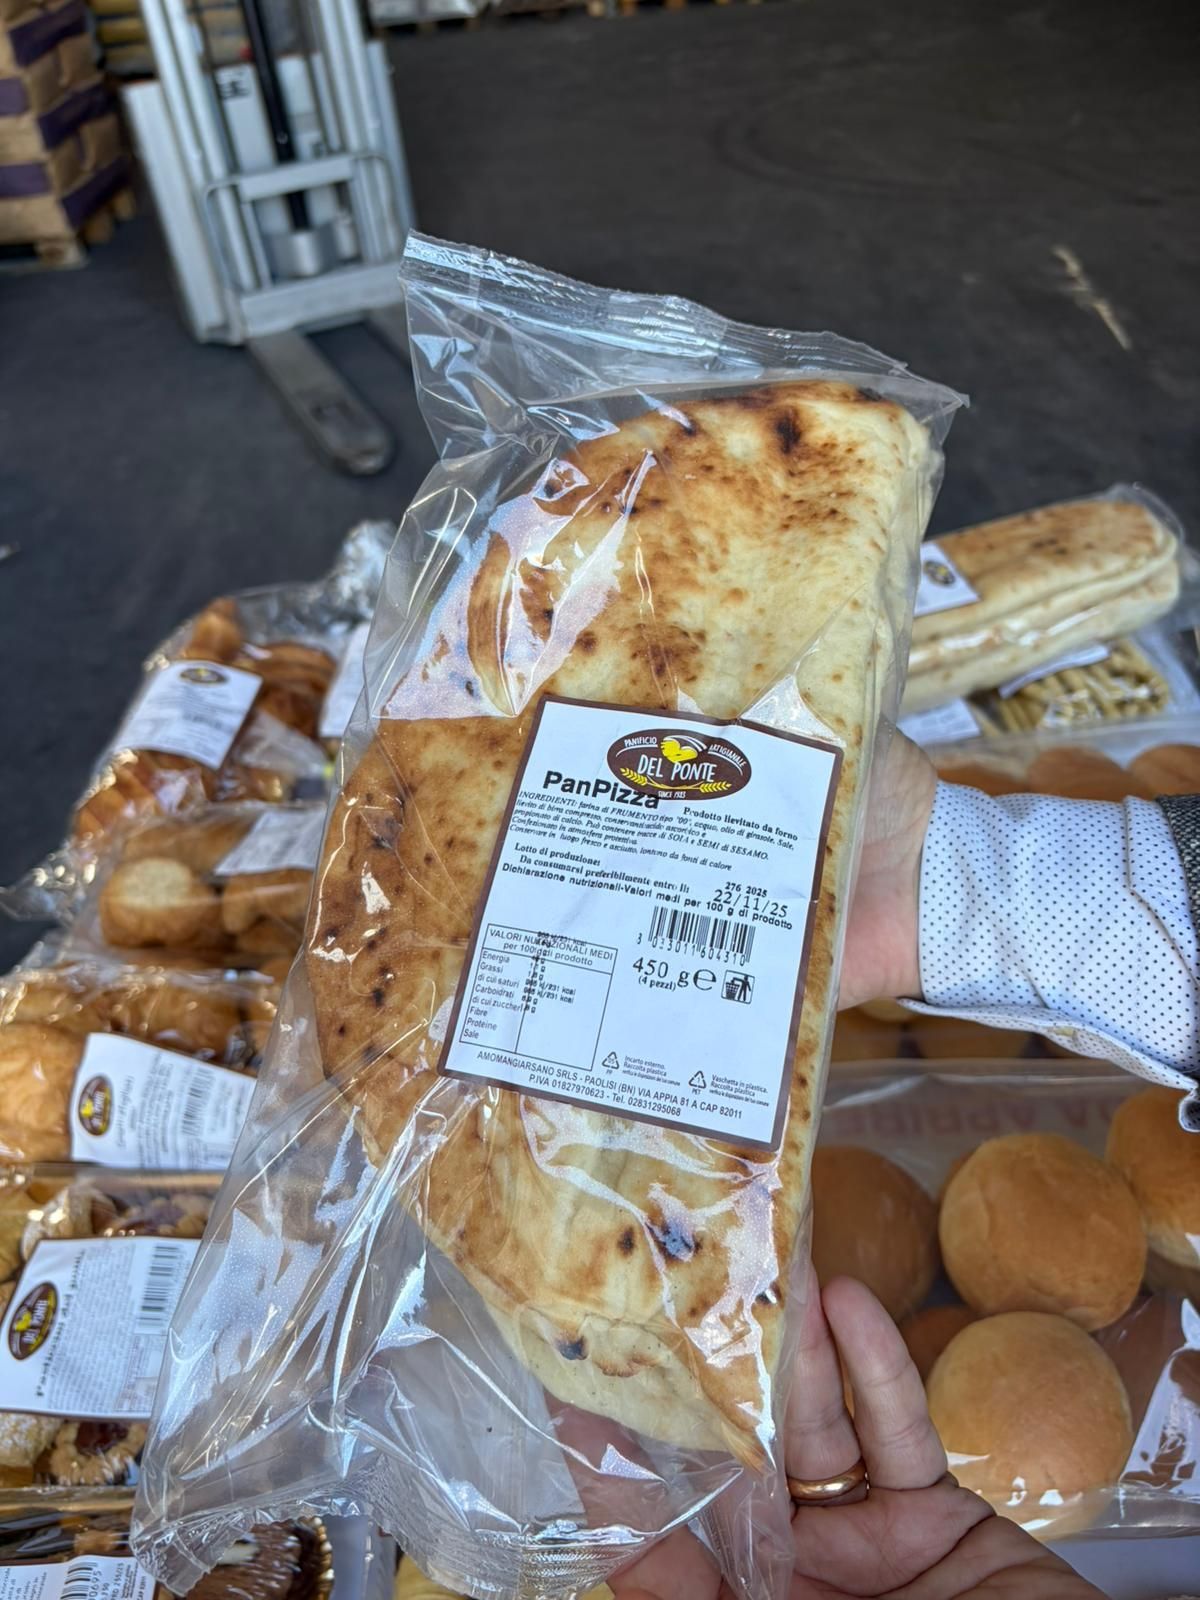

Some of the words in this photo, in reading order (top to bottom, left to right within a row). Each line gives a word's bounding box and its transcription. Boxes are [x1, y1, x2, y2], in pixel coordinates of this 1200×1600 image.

[624, 737, 657, 747] PANIFICIO
[710, 744, 746, 767] ARTIGIANALE
[637, 754, 663, 778] DEL
[671, 761, 717, 783] PONTE
[543, 770, 661, 809] PanPizza
[519, 791, 578, 807] INGREDIENTI:
[578, 801, 600, 811] farina
[610, 807, 659, 821] FRUMENTO
[720, 826, 735, 835] olio
[683, 806, 722, 822] Prodotto
[724, 814, 760, 830] lievitato
[762, 824, 773, 833] da
[775, 827, 798, 841] forno
[552, 814, 561, 822] di
[585, 820, 601, 829] Può
[601, 825, 636, 836] contenere
[667, 833, 689, 843] SOIA
[697, 839, 720, 850] SEMI
[720, 844, 730, 852] di
[558, 824, 566, 832] in
[567, 827, 603, 839] atmosfera
[560, 833, 580, 843] luogo
[580, 837, 602, 847] fresco
[669, 852, 679, 860] da
[681, 853, 699, 864] fonti
[699, 858, 708, 866] di
[709, 861, 732, 871] calore
[514, 842, 537, 854] Lotto
[539, 847, 549, 856] di
[549, 851, 601, 866] produzione:
[725, 881, 741, 892] 276
[746, 886, 767, 898] 2025
[502, 862, 565, 882] Dichiarazione
[569, 877, 652, 898] nutrizionali-Valori
[656, 893, 681, 903] medi
[684, 898, 701, 908] per
[706, 901, 723, 912] 100
[727, 907, 734, 916] g
[738, 908, 749, 918] di
[752, 913, 793, 930] prodotto
[519, 855, 532, 864] Da
[533, 859, 584, 874] consumarsi
[585, 870, 650, 886] preferibilmente
[653, 880, 677, 890] entro
[713, 889, 788, 918] 22/11/25
[490, 929, 522, 942] VALORI
[589, 948, 613, 960] MEDI
[503, 942, 518, 950] per
[554, 952, 593, 966] prodotto
[480, 961, 504, 973] Grassi
[482, 951, 510, 964] Energia
[498, 978, 519, 988] saturi
[632, 957, 669, 979] 450
[677, 971, 690, 988] g
[475, 984, 514, 999] Carboidrati
[649, 979, 678, 992] pezzi)
[469, 1006, 488, 1017] Fibre
[480, 998, 492, 1006] cui
[463, 1028, 479, 1039] Sale
[466, 1017, 497, 1031] Proteine
[623, 1061, 646, 1072] Raccolta
[646, 1067, 667, 1077] plastica
[711, 1074, 739, 1086] Vaschetta
[477, 1051, 555, 1076] AMOMANGIARSANO
[556, 1068, 578, 1081] SRLS
[584, 1075, 617, 1090] PAOLISI
[618, 1083, 636, 1096] (BN)
[638, 1087, 651, 1098] VIA
[652, 1091, 678, 1105] APPIA
[691, 1100, 698, 1109] A
[699, 1101, 718, 1113] CAP
[719, 1106, 742, 1119] 82011
[528, 1073, 549, 1086] P.IVA
[612, 1092, 625, 1104] Tel.
[710, 1081, 733, 1092] Raccolta
[734, 1087, 755, 1097] plastica
